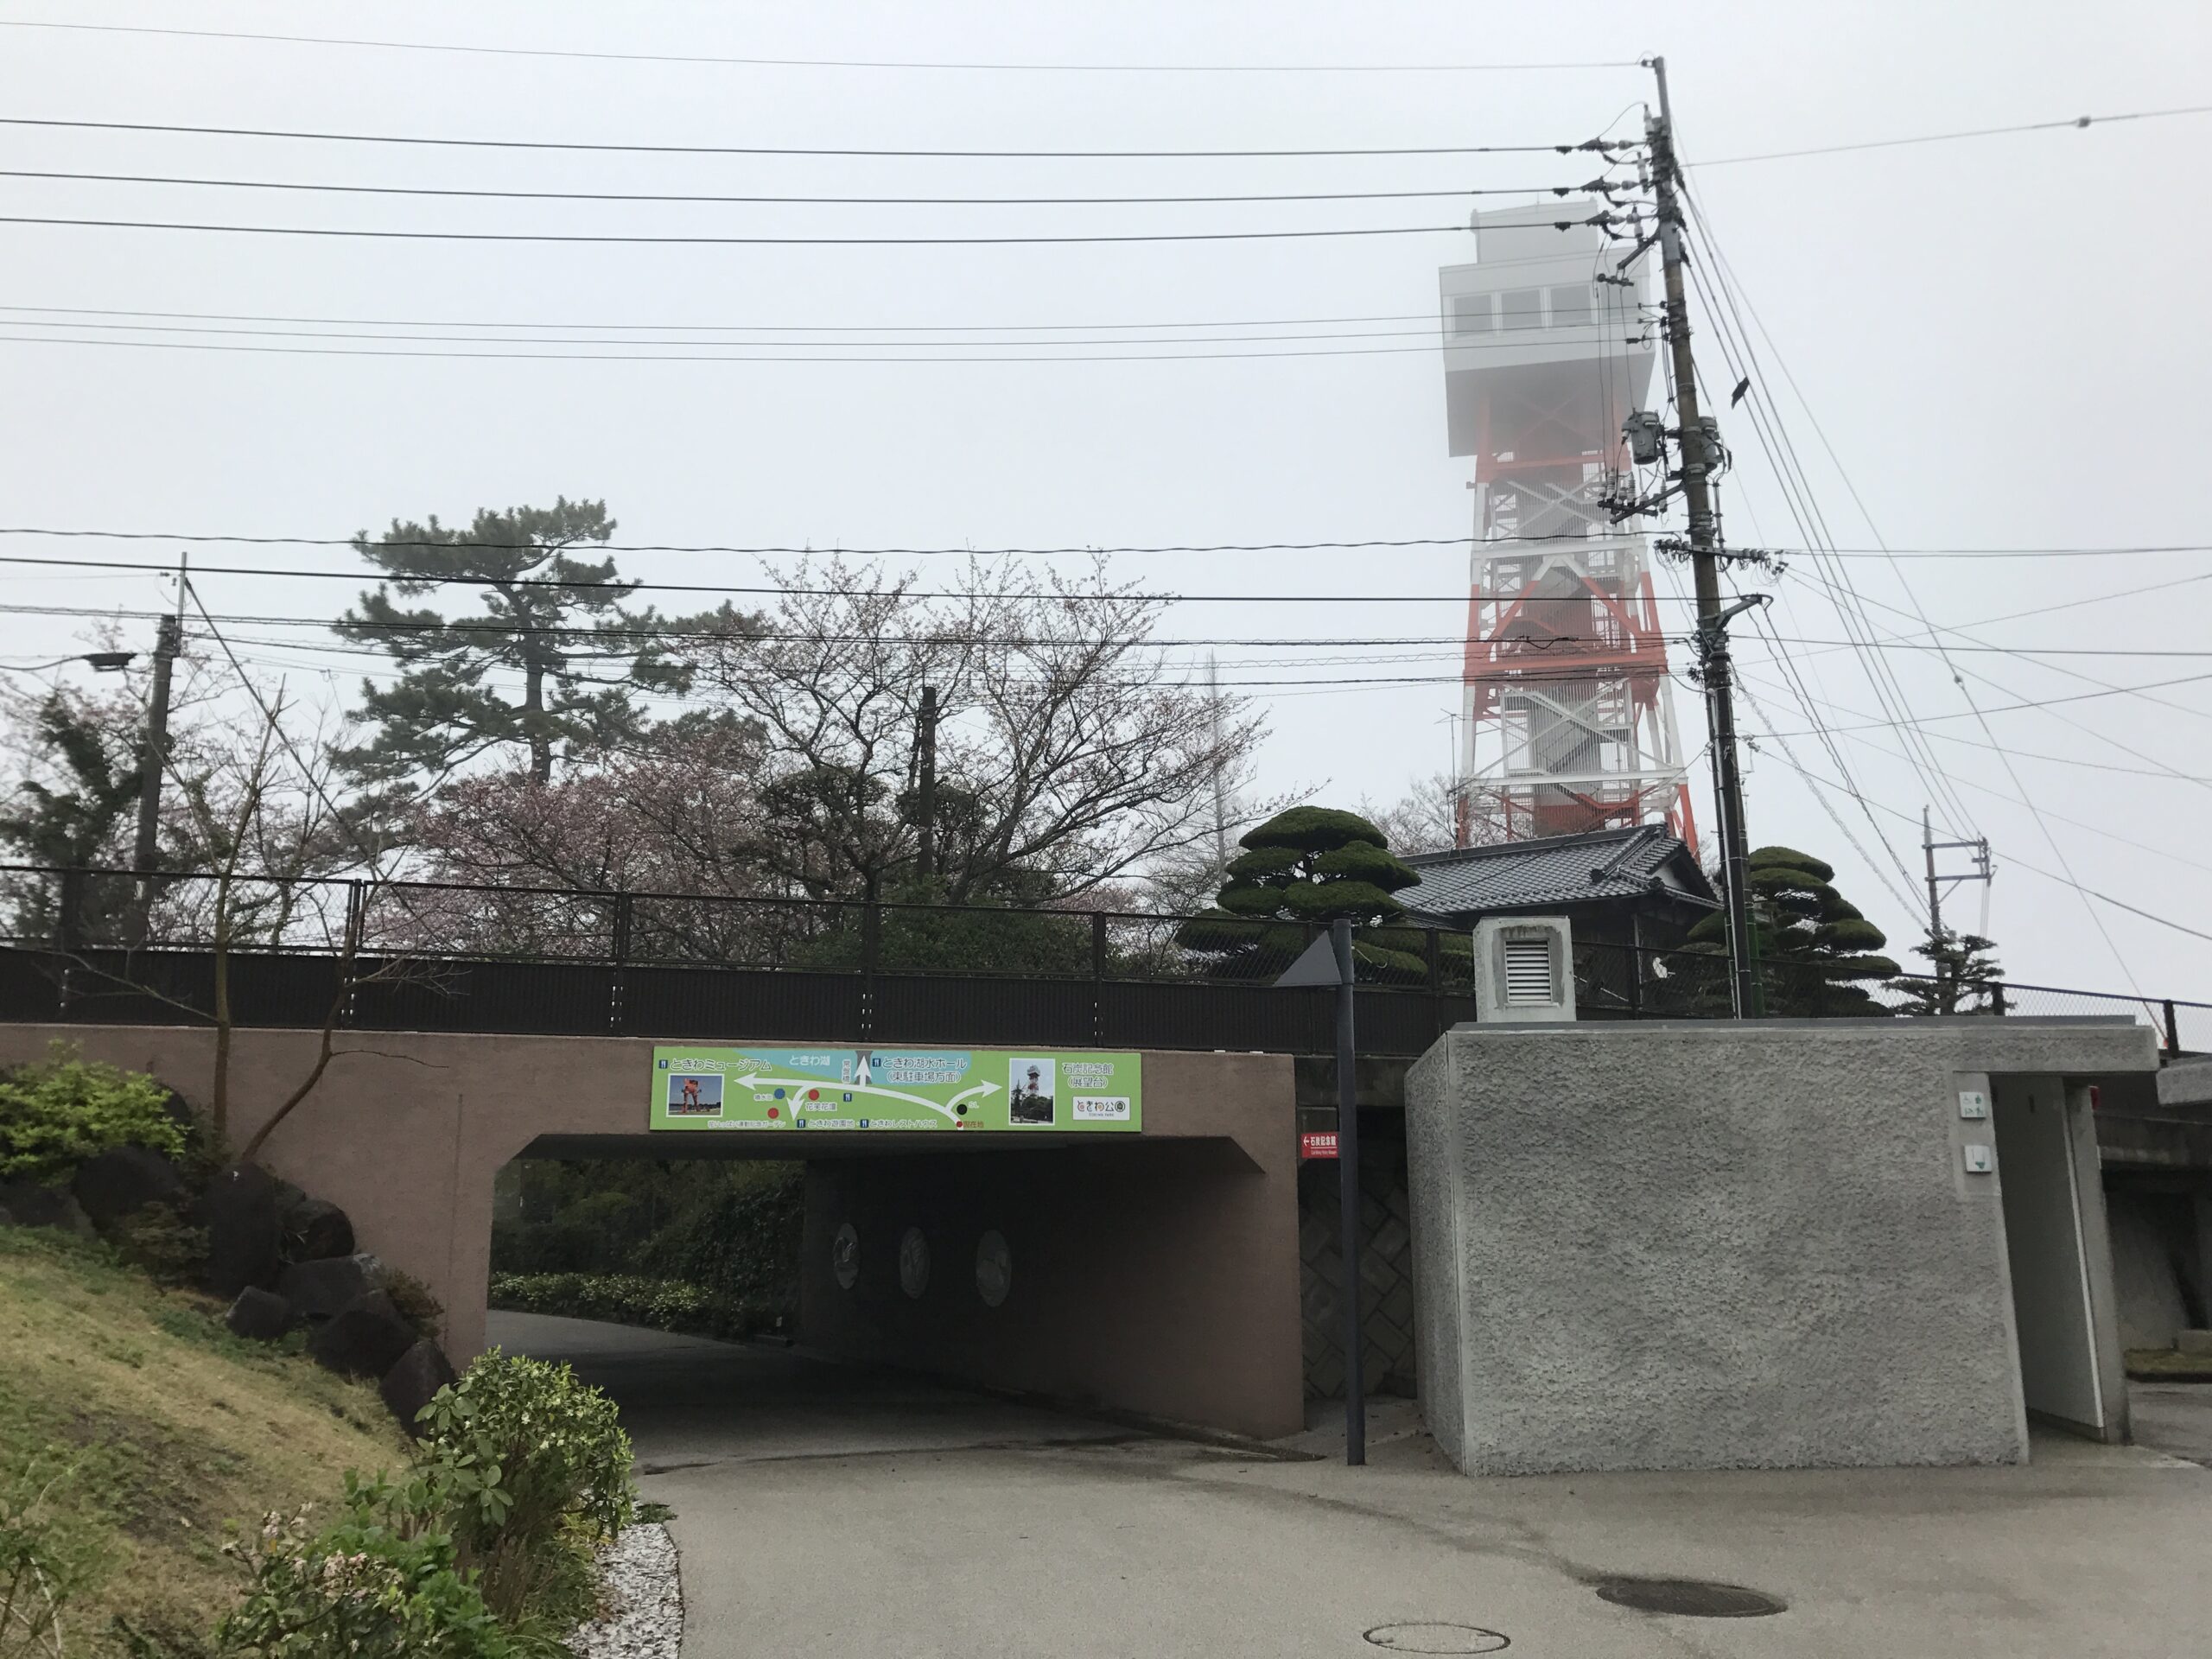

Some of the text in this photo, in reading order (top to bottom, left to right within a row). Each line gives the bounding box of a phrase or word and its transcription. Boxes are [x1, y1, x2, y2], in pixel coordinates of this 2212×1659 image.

[670, 1058, 772, 1071] ときわミュージアム
[789, 1055, 830, 1066] ときわ湖
[882, 1057, 967, 1069] ときわ湖水ホール
[1062, 1062, 1115, 1076] 石炭記念館
